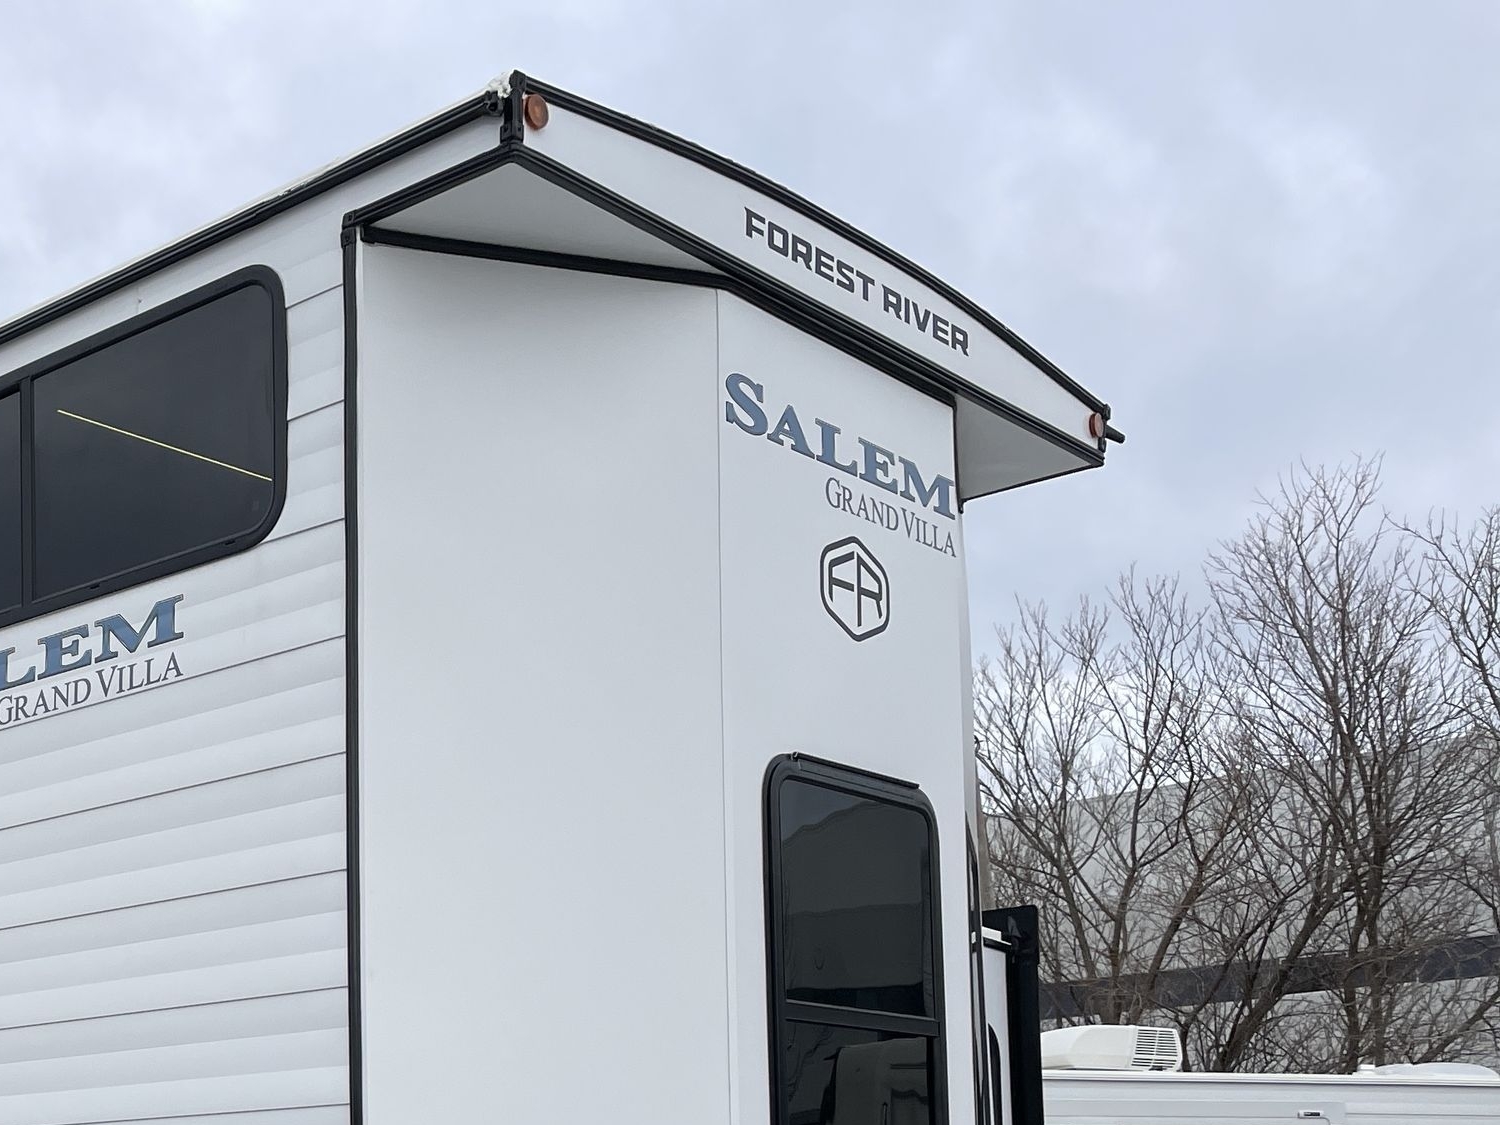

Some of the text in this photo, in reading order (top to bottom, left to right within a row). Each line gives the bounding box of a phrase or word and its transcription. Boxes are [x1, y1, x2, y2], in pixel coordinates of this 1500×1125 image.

[744, 207, 970, 357] FOREST RIVER
[725, 373, 956, 520] SALEM
[825, 477, 957, 558] GRAND VILLA
[96, 652, 184, 698] VILLA
